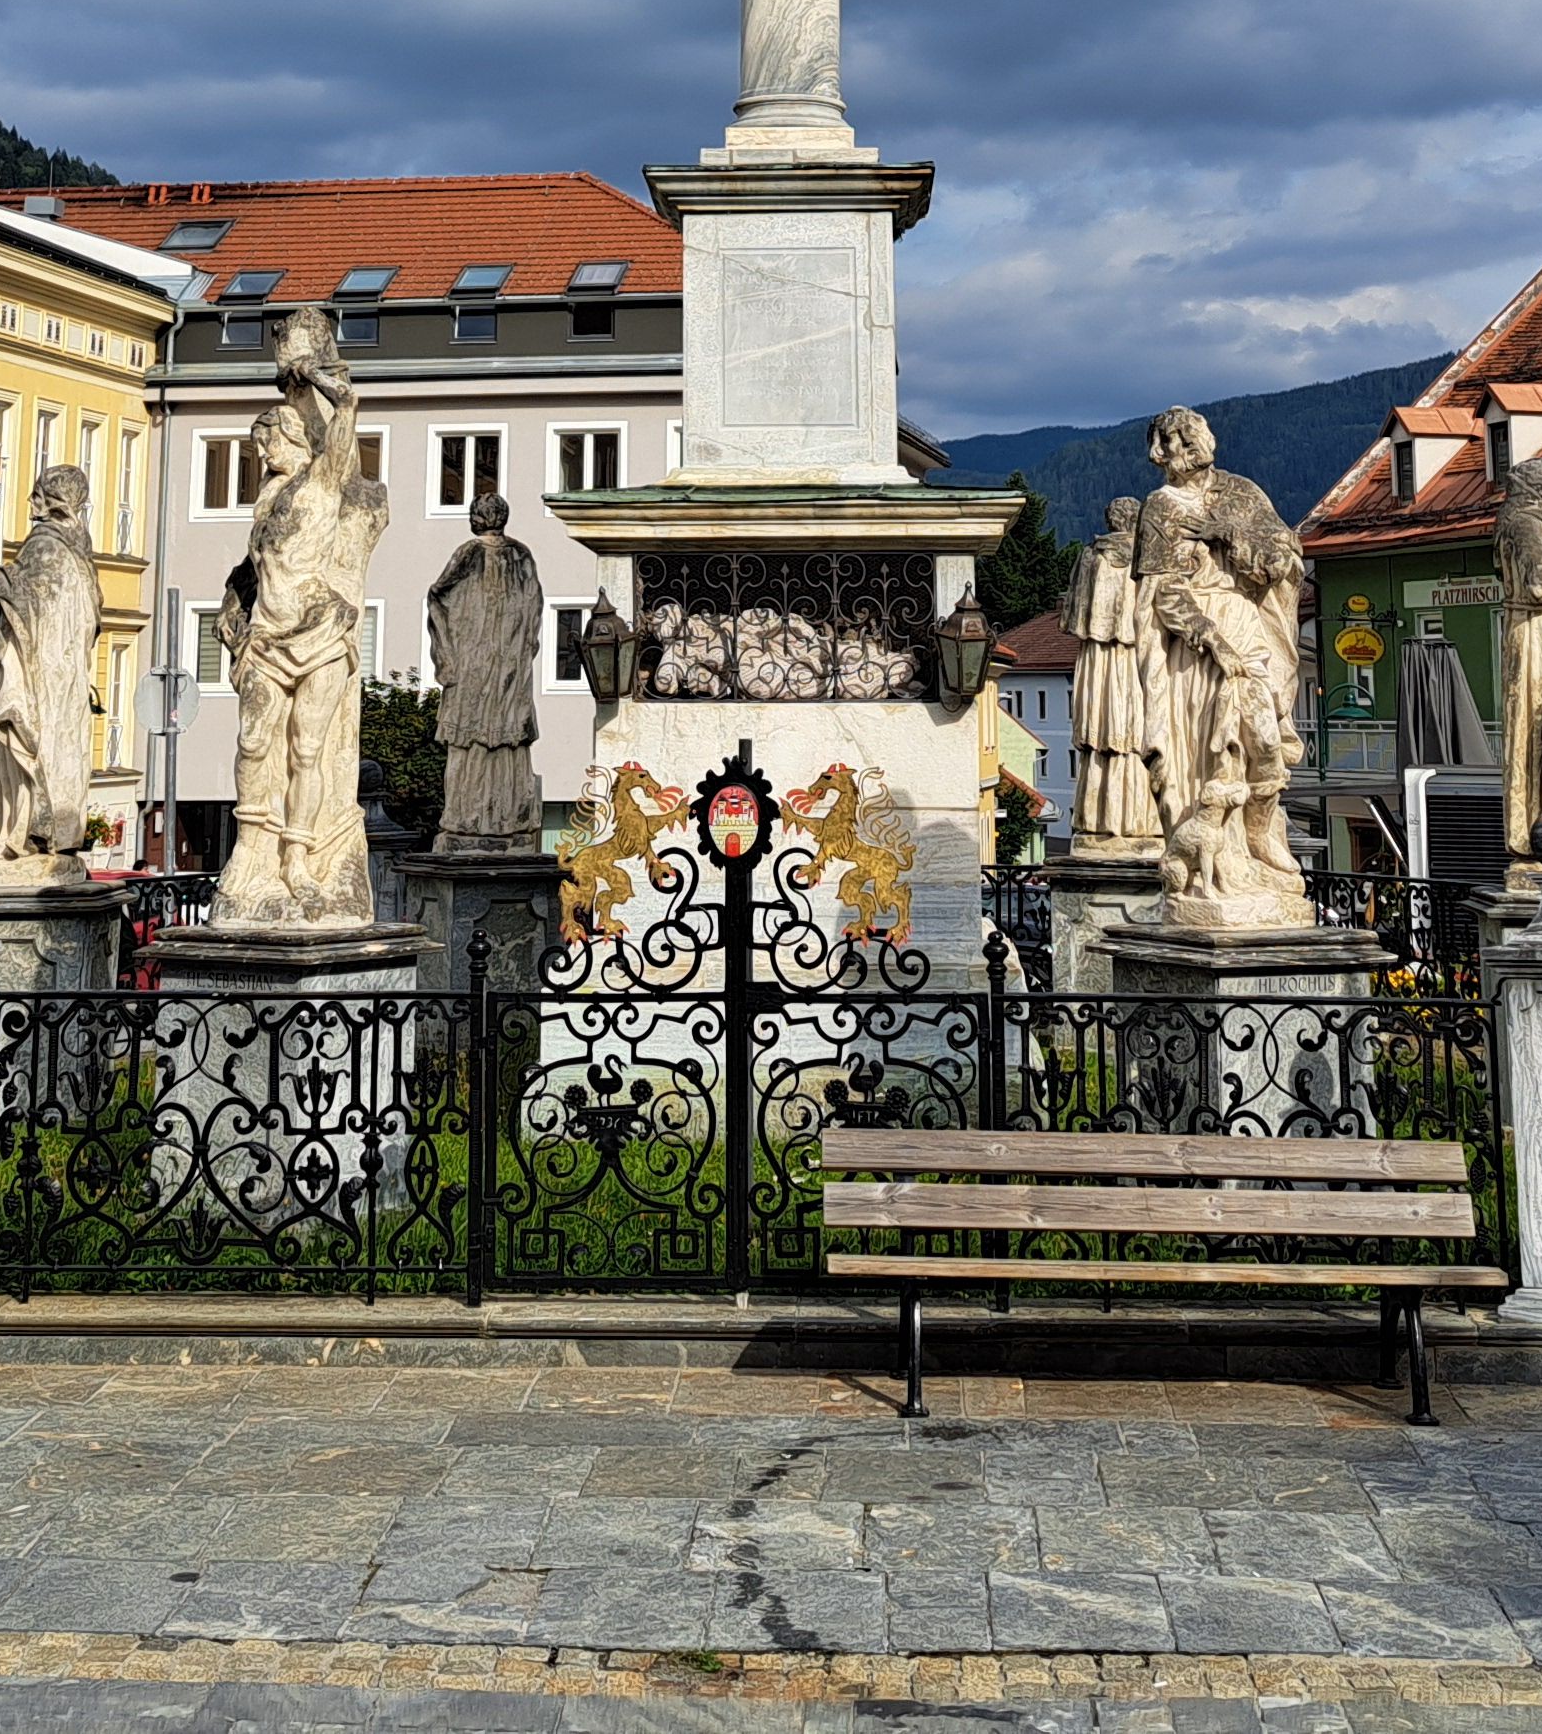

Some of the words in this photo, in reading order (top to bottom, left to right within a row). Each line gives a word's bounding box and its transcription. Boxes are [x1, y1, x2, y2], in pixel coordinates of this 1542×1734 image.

[1432, 586, 1500, 606] PLATZHIRSCH
[207, 972, 274, 991] SEBASTIAN
[1278, 975, 1336, 993] ROCHUS
